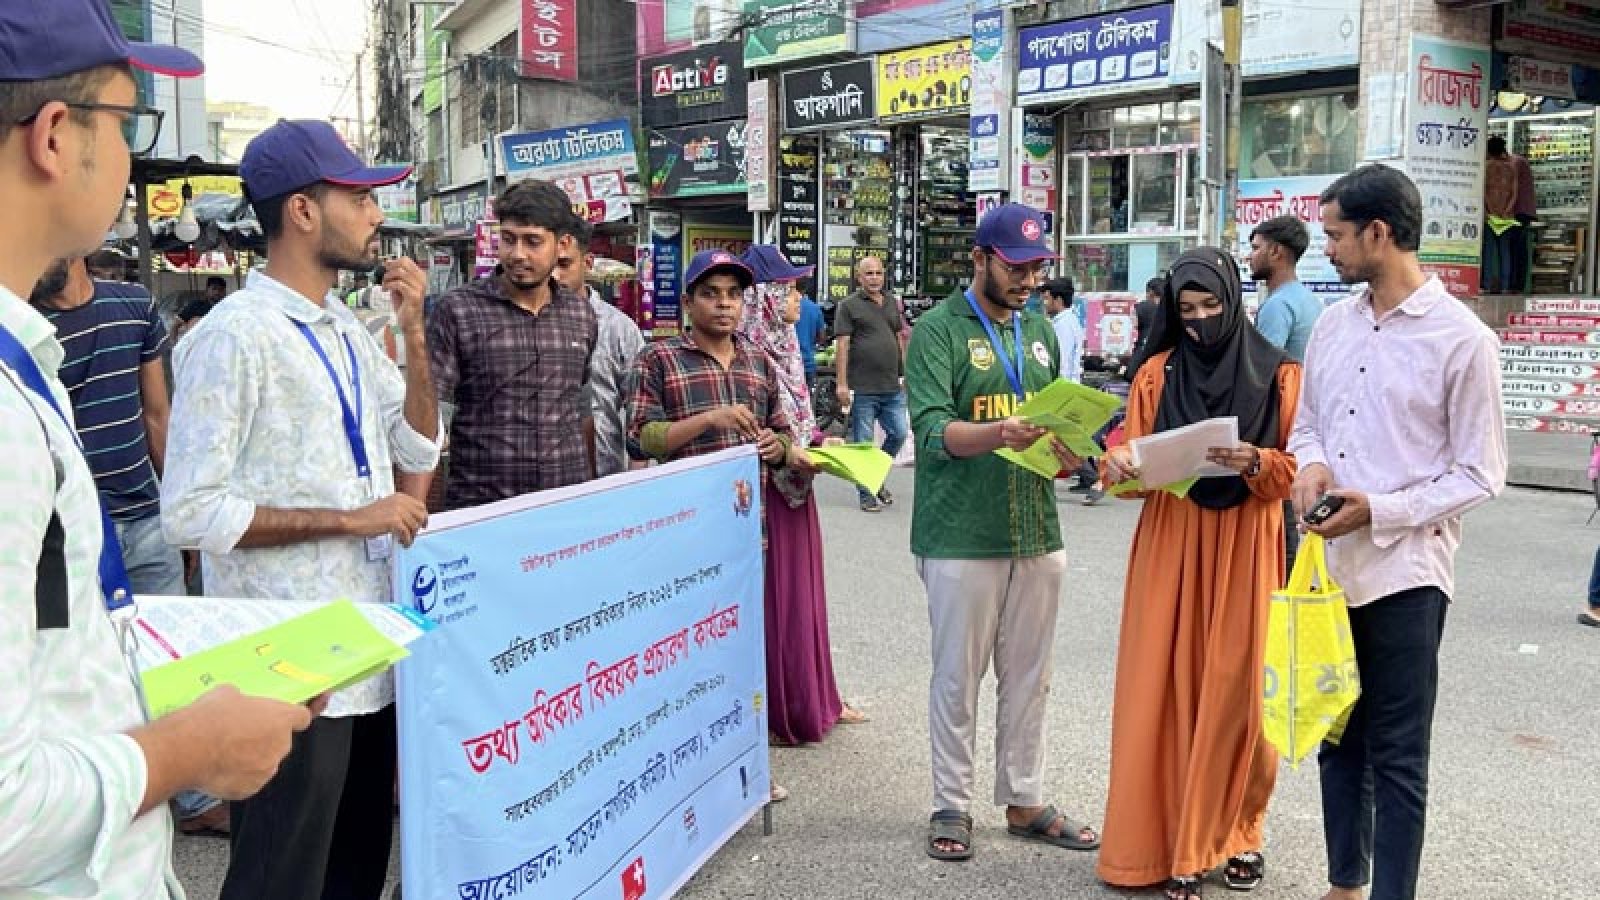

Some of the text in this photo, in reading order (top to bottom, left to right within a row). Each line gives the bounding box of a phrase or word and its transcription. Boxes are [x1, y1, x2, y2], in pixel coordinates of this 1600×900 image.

[1096, 18, 1159, 50] টেলিকম
[653, 57, 727, 94] Active
[1418, 54, 1482, 111] রিজেন্ট
[793, 83, 864, 120] আফগানি
[512, 128, 625, 167] অরণ্য টেলিকম
[1417, 117, 1479, 150] ওয়াচ সার্ভিস
[788, 226, 811, 239] Live
[538, 627, 562, 653] তথ্য
[563, 616, 591, 643] জানার
[593, 601, 625, 631] অধিকার
[627, 591, 648, 615] দিবস
[462, 720, 520, 773] তথ্য
[523, 689, 583, 747] অধিকার
[587, 655, 639, 712] বিষয়ক
[692, 603, 739, 649] কার্যক্রম
[566, 807, 603, 855] সচেতন
[605, 780, 638, 822] নাগরিক
[638, 751, 666, 790] কমিটি
[708, 699, 743, 741] রাজশাহী
